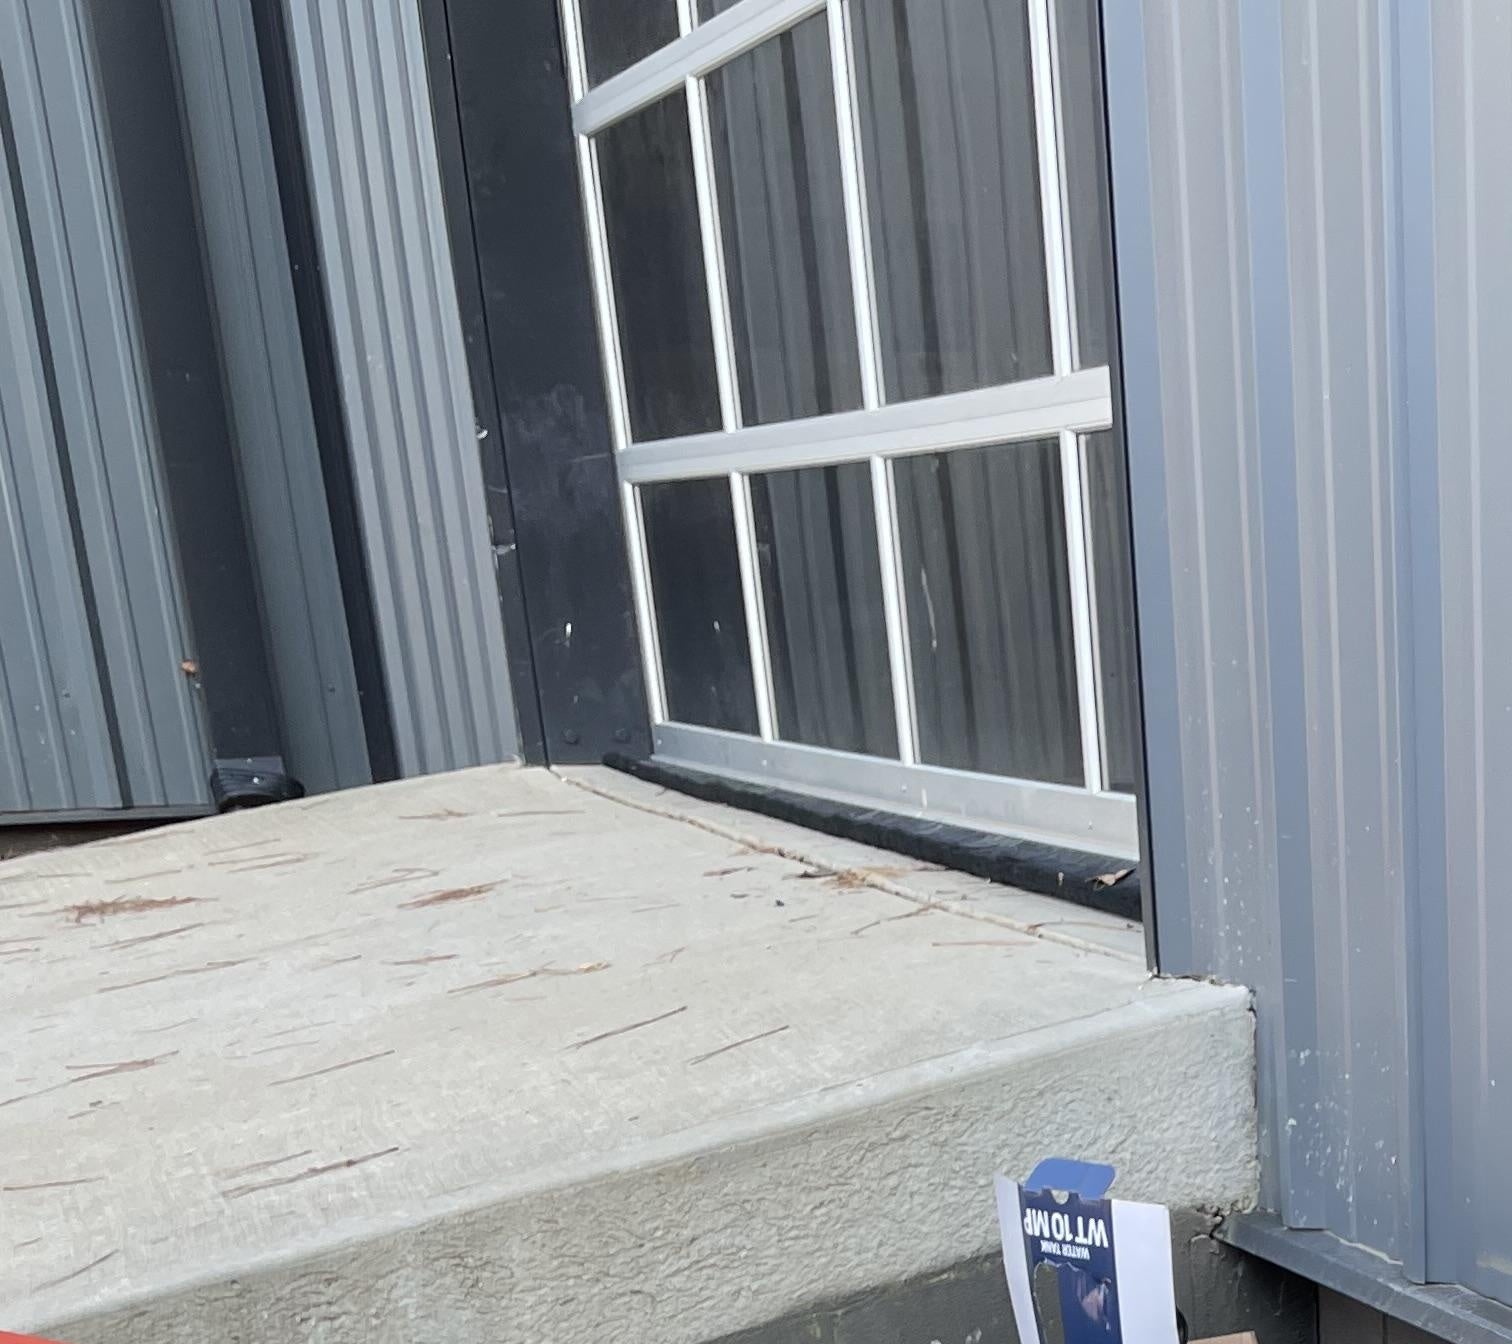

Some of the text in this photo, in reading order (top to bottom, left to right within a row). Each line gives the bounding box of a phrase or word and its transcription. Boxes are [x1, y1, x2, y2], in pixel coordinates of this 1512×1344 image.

[1023, 1207, 1109, 1248] WT 10 MP
[1040, 1239, 1091, 1260] WATER TANK
